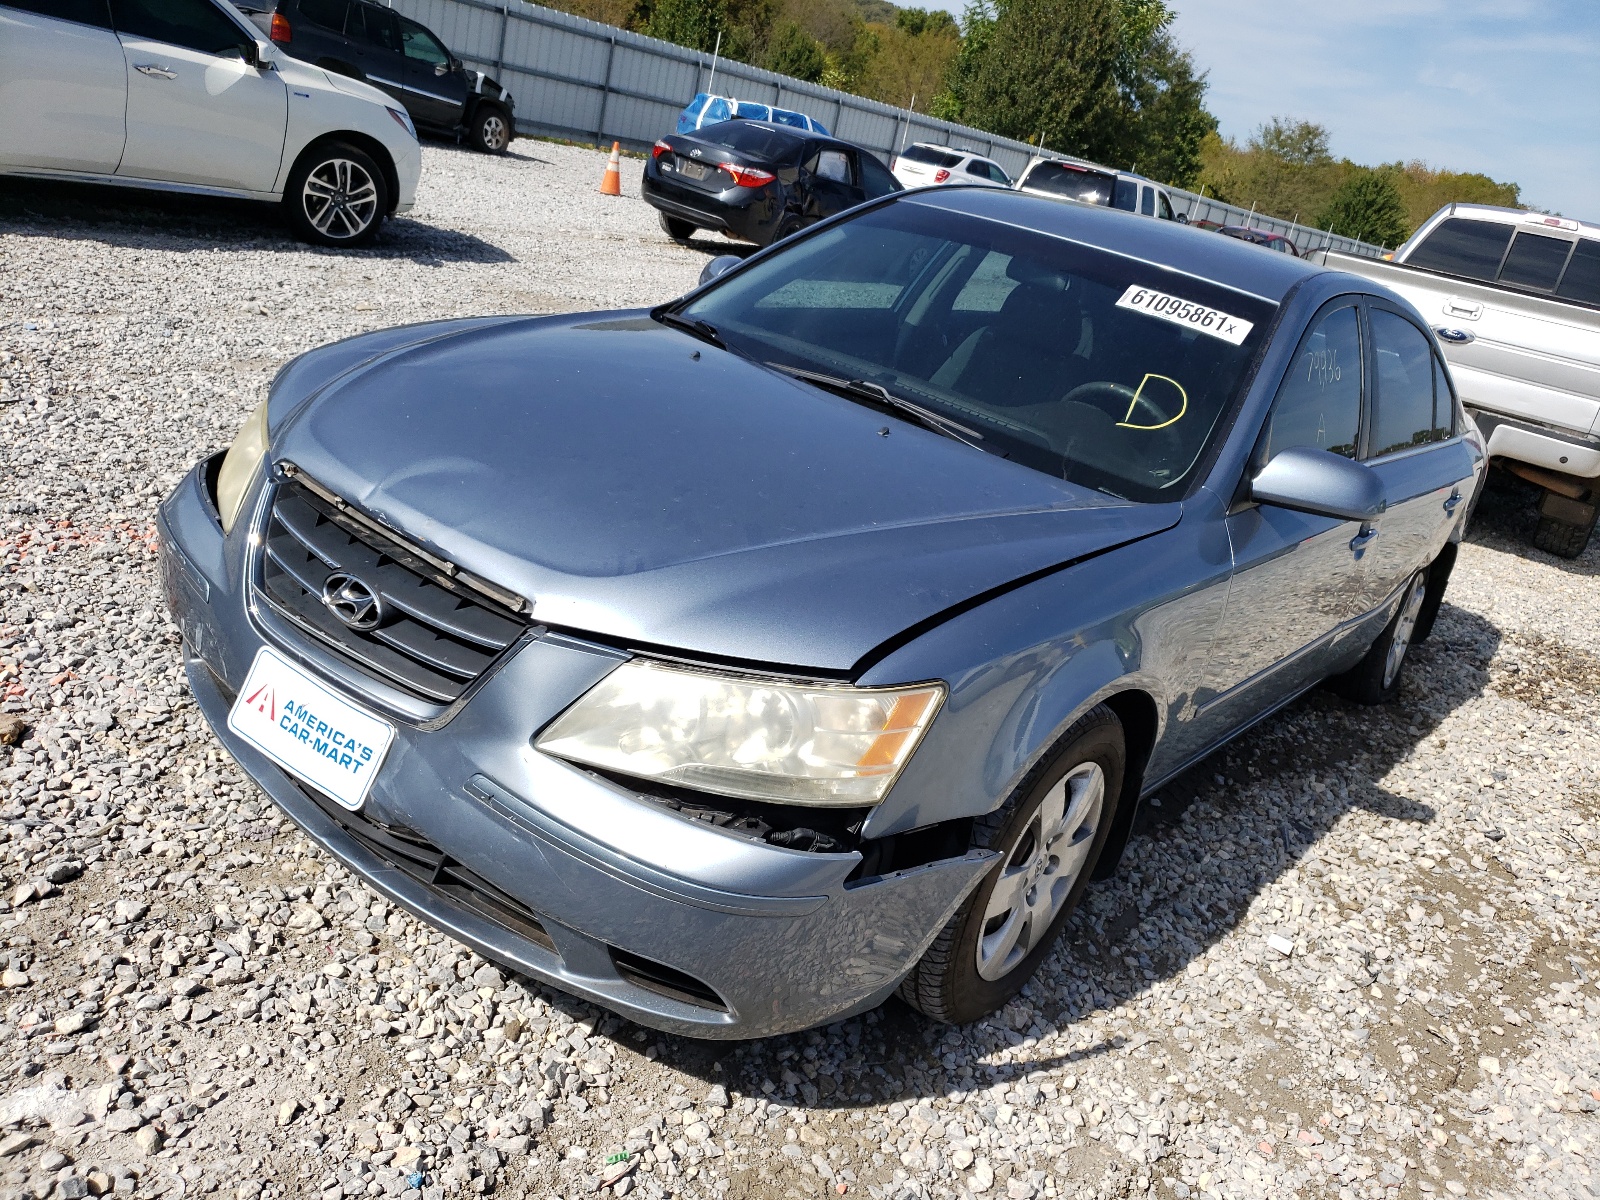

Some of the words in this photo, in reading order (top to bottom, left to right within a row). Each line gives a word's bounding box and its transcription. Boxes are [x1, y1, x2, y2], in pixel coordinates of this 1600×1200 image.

[1115, 373, 1188, 430] D
[279, 714, 365, 774] CAR-MART
[283, 699, 374, 762] AMERICA'S
